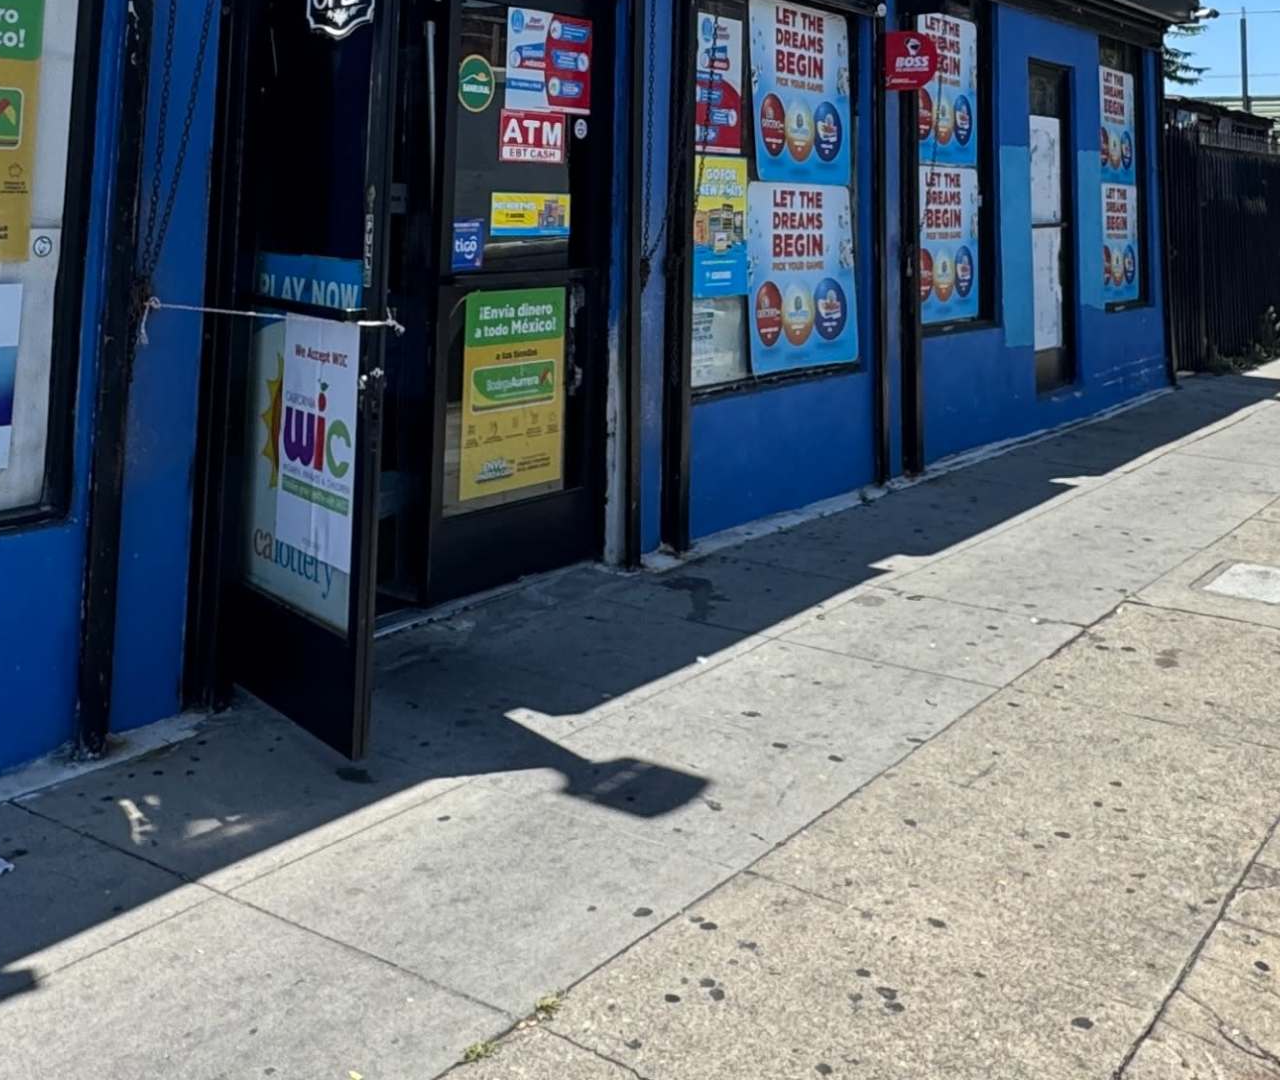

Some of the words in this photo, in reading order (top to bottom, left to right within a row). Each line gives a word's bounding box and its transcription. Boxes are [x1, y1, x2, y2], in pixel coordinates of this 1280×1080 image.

[776, 6, 797, 27] LET
[802, 11, 824, 34] THE
[925, 15, 940, 32] LET
[776, 27, 824, 54] DREAMS
[776, 49, 824, 80] BEGIN
[896, 56, 930, 68] BOSS
[503, 118, 562, 147] ATM
[509, 148, 528, 159] EBT
[530, 149, 556, 160] CASH
[925, 172, 941, 187] LET
[943, 173, 961, 188] THE
[773, 189, 795, 208] LET
[800, 190, 823, 210] THE
[926, 190, 961, 206] DREAMS
[773, 211, 823, 231] DREAMS
[927, 209, 961, 229] BEGIN
[773, 233, 824, 258] BEGIN
[311, 279, 359, 310] NOW
[518, 302, 552, 319] dinero
[474, 328, 482, 338] a
[484, 322, 509, 338] todo
[511, 316, 557, 335] México!
[295, 343, 305, 357] We
[307, 346, 331, 365] Accept
